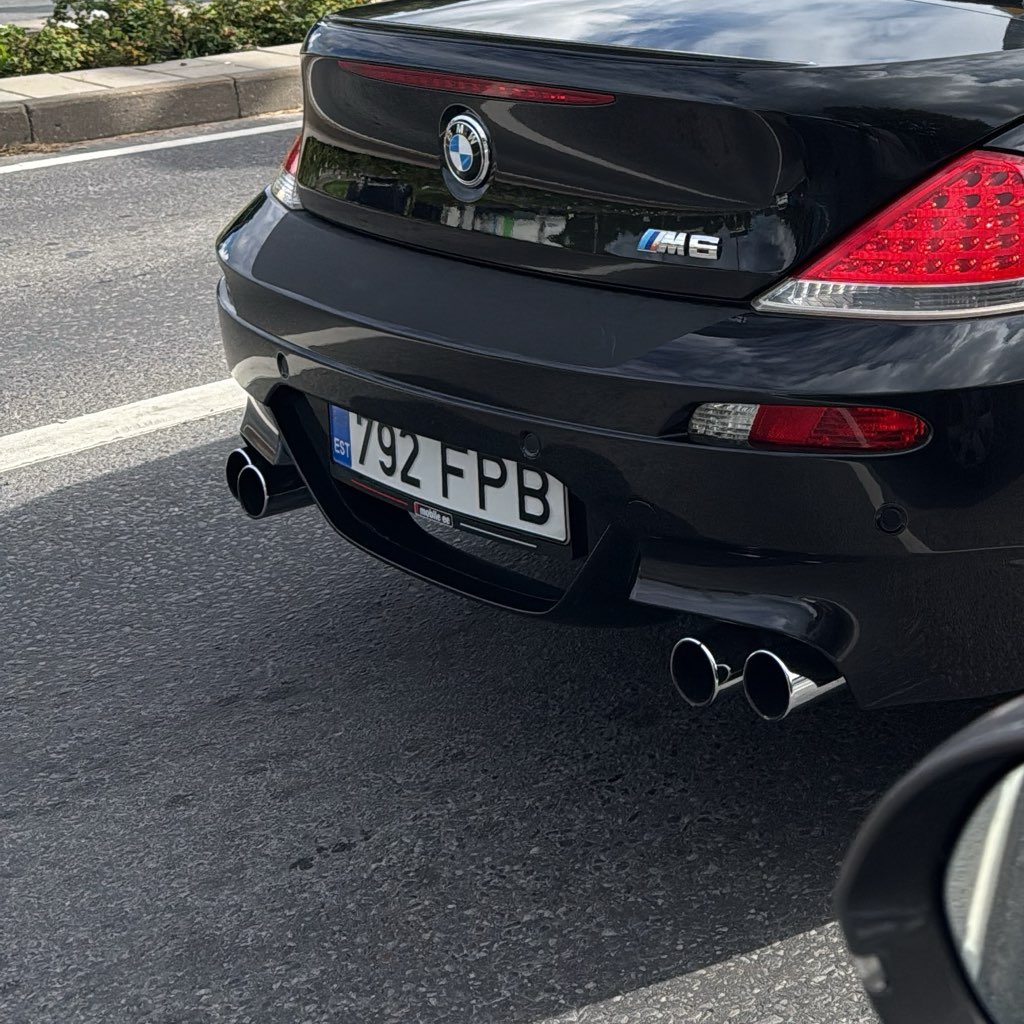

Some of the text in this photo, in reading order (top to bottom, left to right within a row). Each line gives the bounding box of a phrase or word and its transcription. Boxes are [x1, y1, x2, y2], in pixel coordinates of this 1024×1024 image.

[446, 123, 478, 145] BMW
[650, 229, 720, 260] M6
[333, 437, 351, 459] EST
[356, 414, 551, 526] 792 FPB
